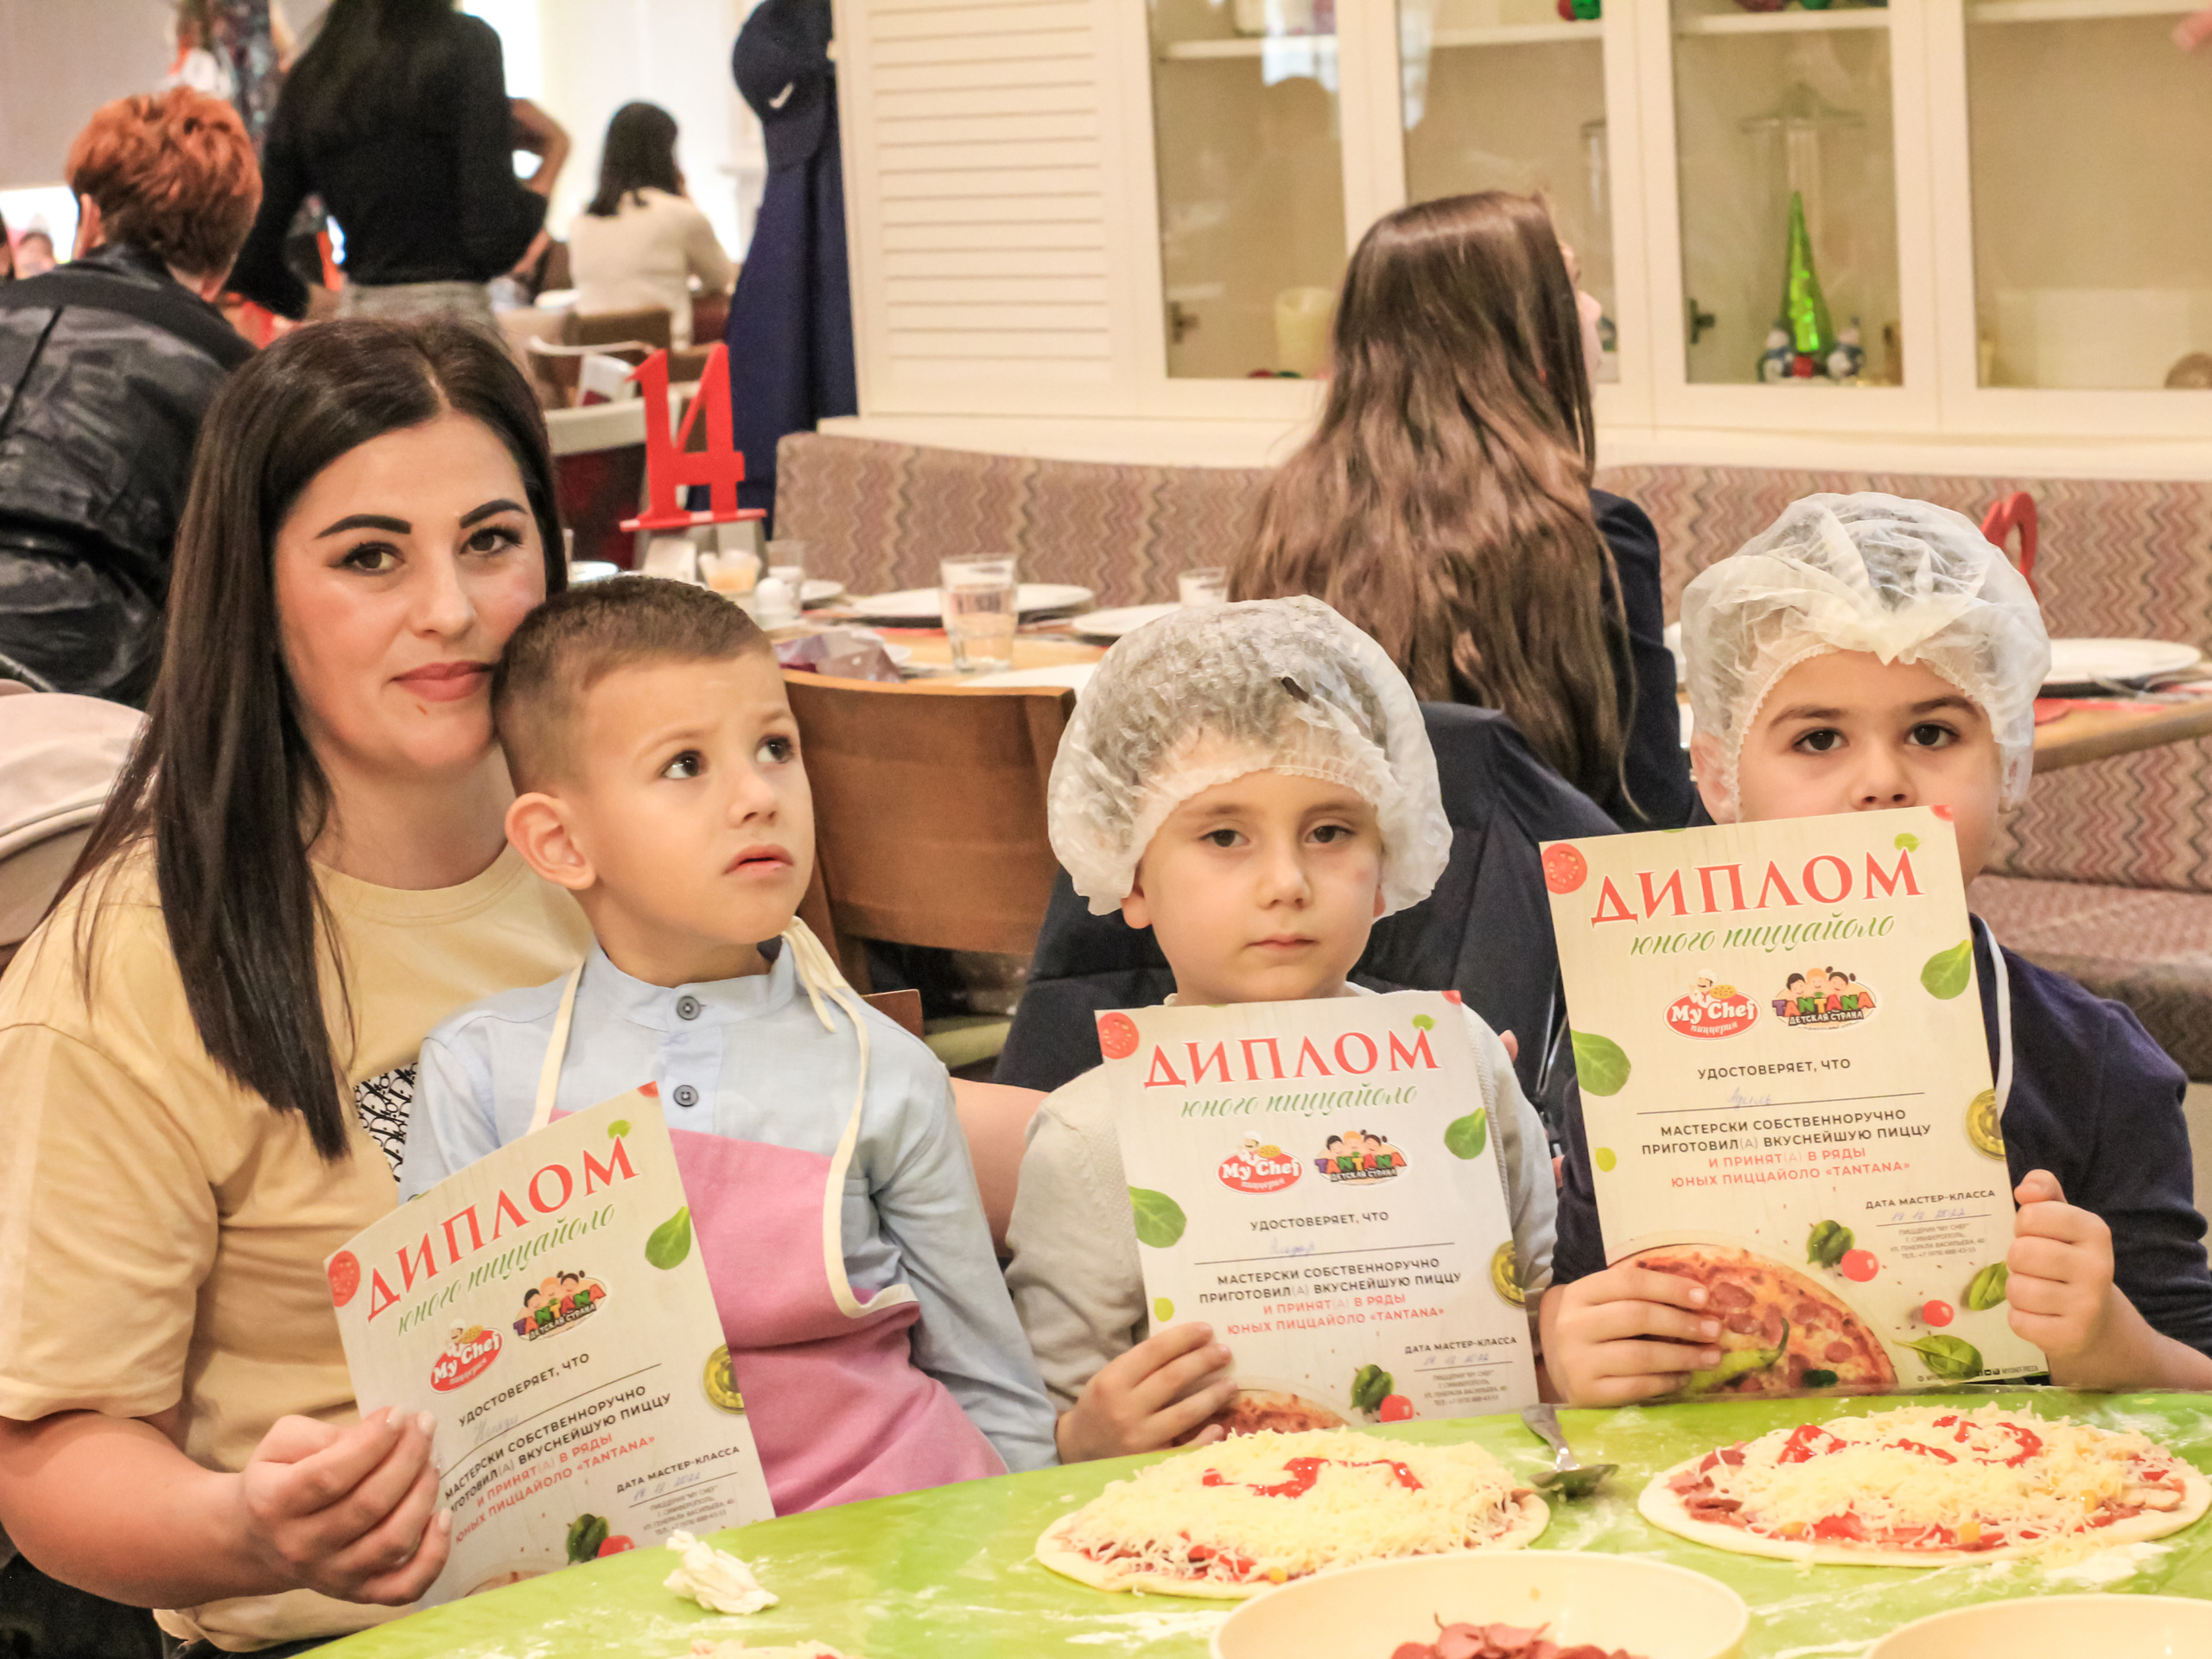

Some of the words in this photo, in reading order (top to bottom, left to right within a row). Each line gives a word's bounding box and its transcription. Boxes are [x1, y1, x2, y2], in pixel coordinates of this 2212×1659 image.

[626, 342, 745, 522] 14
[1591, 848, 1926, 929] ДИПЛОМ
[1630, 929, 1716, 956] юного
[1723, 910, 1895, 953] пиццайоло
[1671, 1005, 1702, 1024] My
[1707, 1000, 1757, 1020] Chef
[1771, 991, 1877, 1017] TANTANA
[1789, 1013, 1828, 1026] ДЕТСКАЯ
[1829, 1010, 1865, 1022] СТРАНА
[1143, 1028, 1442, 1090] ДИПЛОМ
[1697, 1061, 1818, 1080] УДОСТОВЕРЯЕТ,
[1821, 1058, 1851, 1071] ЧТО
[1181, 1096, 1259, 1118] юного
[1265, 1082, 1417, 1117] пиццайоло
[1661, 1121, 1749, 1136] МАСТЕРСКИ
[1753, 1109, 1907, 1131] СОБСТВЕННОРУЧНО
[1642, 1138, 1759, 1155] ПРИГОТОВИЛ(А)
[1764, 1129, 1872, 1148] ВКУСНЕЙШУЮ
[1877, 1124, 1932, 1141] ПИЦЦУ
[1222, 1163, 1251, 1180] My
[1255, 1159, 1300, 1177] Chef
[1314, 1152, 1407, 1174] TANTANA
[1708, 1158, 1719, 1168] И
[1724, 1151, 1803, 1167] ПРИНЯТ(А)
[1808, 1151, 1818, 1161] В
[1822, 1147, 1866, 1161] РЯДЫ
[1671, 1174, 1718, 1188] ЮНЫХ
[1722, 1166, 1821, 1186] ПИЦЦАЙОЛО
[1825, 1160, 1911, 1177] «TANTANA»
[1866, 1198, 1896, 1210] ДАТА
[1898, 1190, 1996, 1206] МАСТЕР-КЛАССА
[368, 1135, 641, 1323] ДИПЛОМ
[1250, 1214, 1359, 1231] УДОСТОВЕРЯЕТ,
[1362, 1211, 1389, 1223] ЧТО
[398, 1279, 462, 1337] юного
[467, 1203, 615, 1293] пиццайоло
[1217, 1269, 1299, 1286] МАСТЕРСКИ
[1304, 1258, 1440, 1279] СОБСТВЕННОРУЧНО
[1199, 1284, 1310, 1304] ПРИГОТОВИЛ(А)
[1314, 1276, 1411, 1294] ВКУСНЕЙШУЮ
[1414, 1272, 1462, 1287] ПИЦЦУ
[513, 1284, 607, 1336] TANTANA
[1263, 1305, 1273, 1315] И
[1354, 1297, 1363, 1307] В
[1367, 1294, 1407, 1306] РЯДЫ
[1227, 1322, 1272, 1335] ЮНЫХ
[1275, 1313, 1366, 1332] ПИЦЦАЙОЛО
[434, 1359, 458, 1384] My
[461, 1332, 501, 1364] Chef
[1405, 1345, 1432, 1354] ДАТА
[1434, 1337, 1517, 1351] МАСТЕР-КЛАССА
[458, 1367, 560, 1427] УДОСТОВЕРЯЕТ,
[562, 1353, 589, 1370] ЧТО
[444, 1448, 505, 1500] МАСТЕРСКИ
[508, 1386, 645, 1452] СОБСТВЕННОРУЧНО
[518, 1414, 616, 1466] ВКУСНЕЙШУЮ
[620, 1393, 671, 1421] ПИЦЦУ
[477, 1497, 485, 1508] И
[559, 1452, 569, 1464] В
[572, 1433, 613, 1457] РЯДЫ
[617, 1477, 645, 1493] ДАТА
[648, 1446, 740, 1481] МАСТЕР-КЛАССА
[455, 1513, 486, 1543] ЮНЫХ
[488, 1467, 572, 1516] ПИЦЦАЙОЛО
